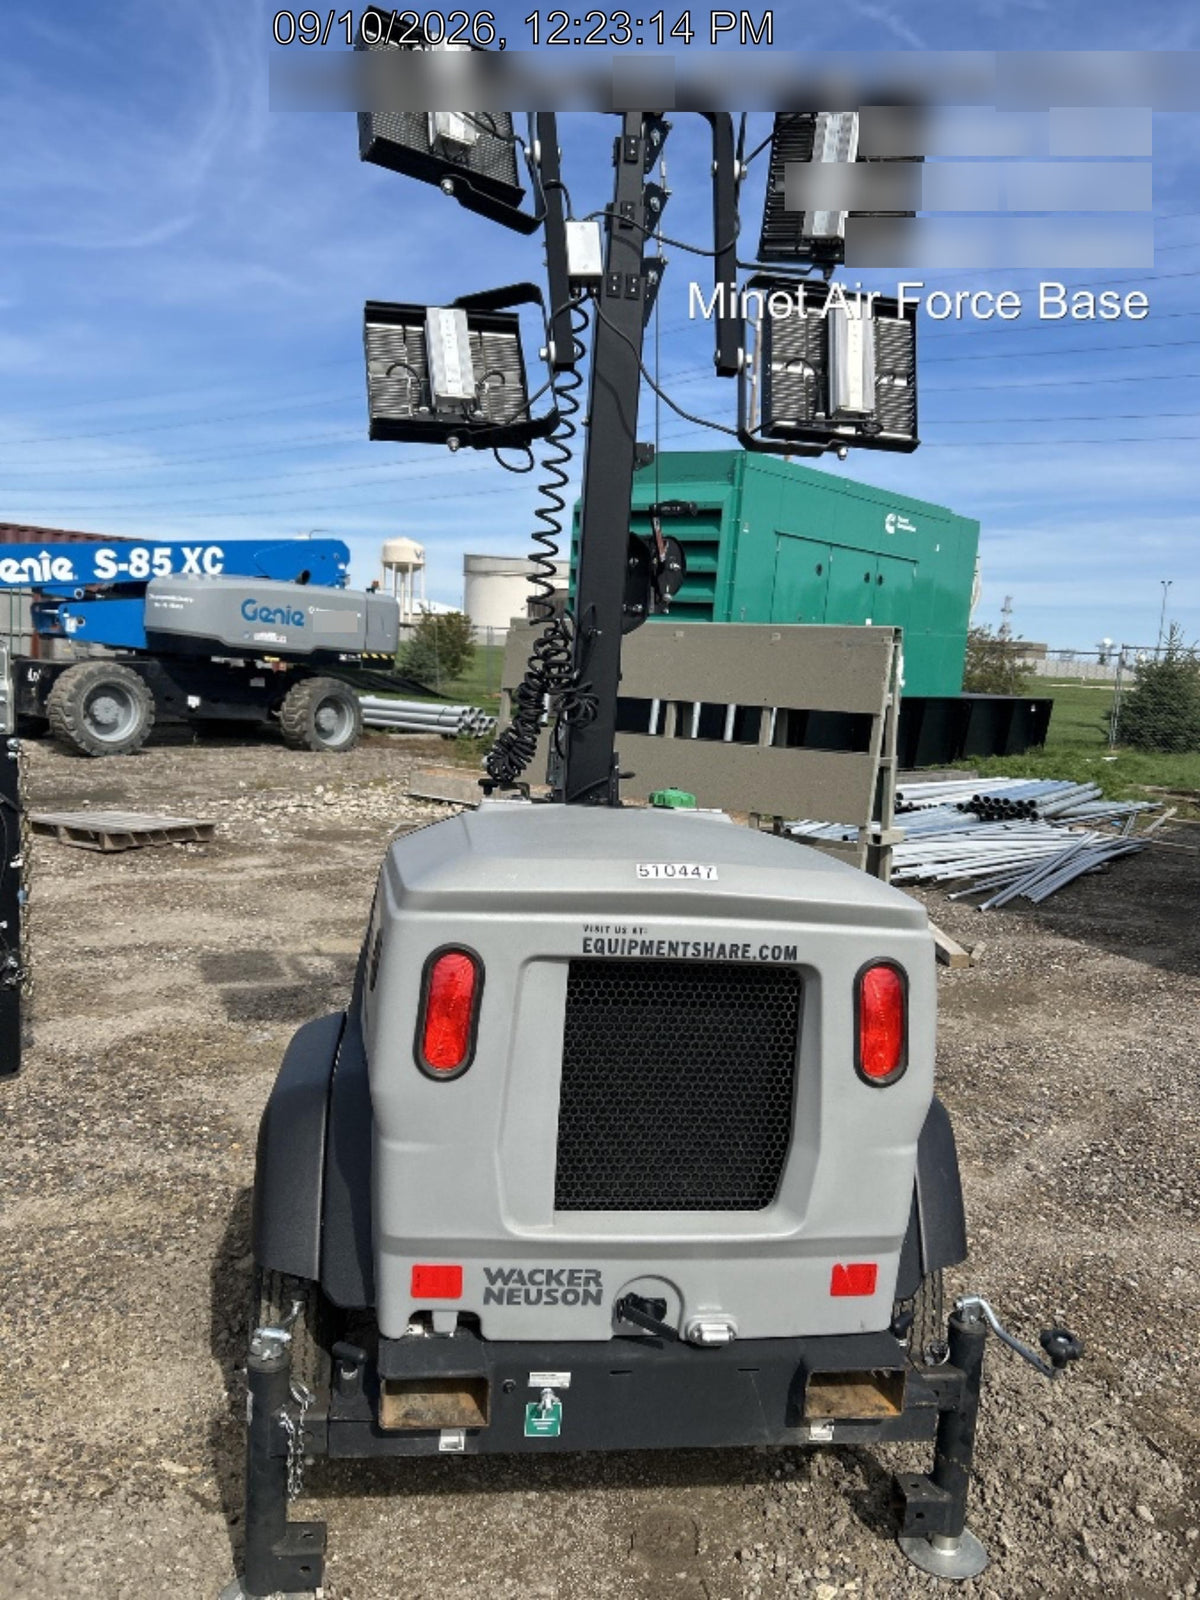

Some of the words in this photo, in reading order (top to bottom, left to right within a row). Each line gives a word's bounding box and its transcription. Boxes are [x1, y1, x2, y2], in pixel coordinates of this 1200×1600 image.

[0, 550, 74, 583] enie
[93, 548, 173, 579] S-85
[181, 546, 224, 575] XC
[241, 598, 305, 626] Genie
[638, 864, 714, 879] 510447
[582, 936, 798, 961] EQUIPMENTSHARE.COM
[483, 1267, 603, 1286] WACKER
[483, 1287, 603, 1306] NEUSON
